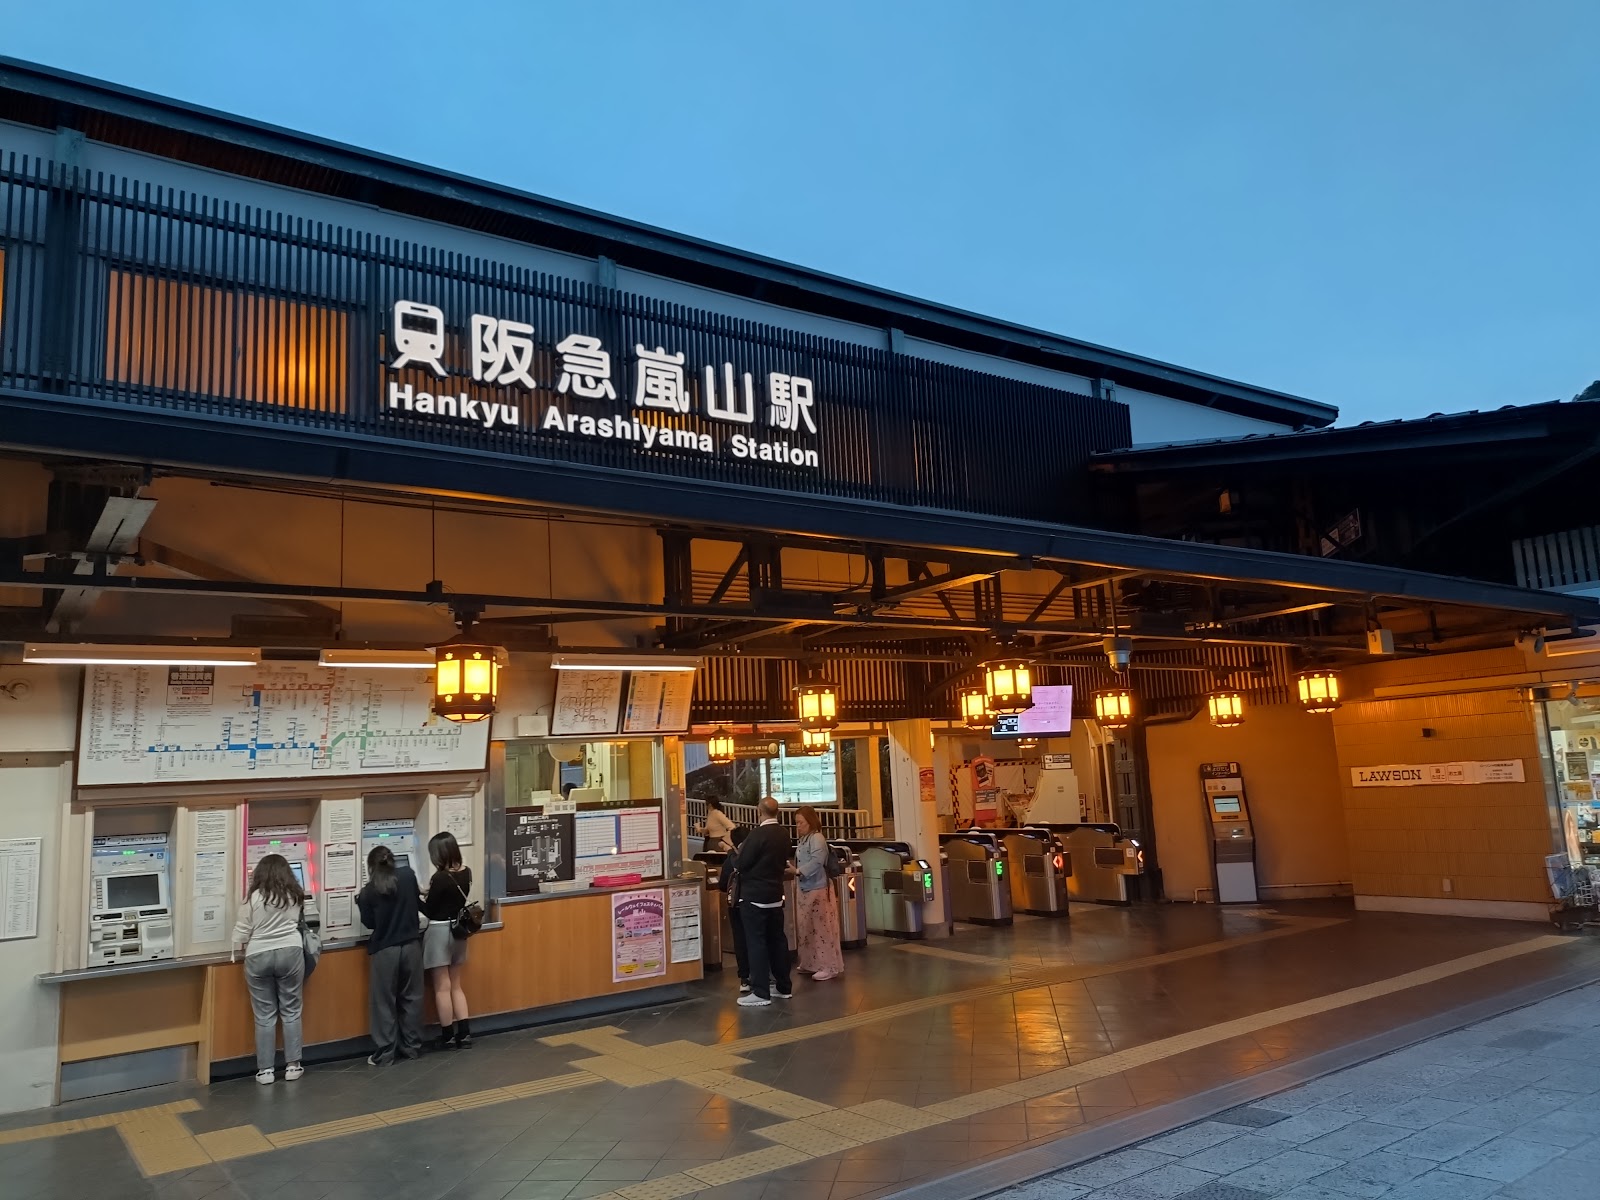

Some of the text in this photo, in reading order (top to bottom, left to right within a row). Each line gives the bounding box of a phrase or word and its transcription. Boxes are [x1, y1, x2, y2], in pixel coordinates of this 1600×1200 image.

[470, 313, 818, 434] 阪急嵐山駅
[388, 382, 819, 469] Hankyu Arashiyama Station
[1358, 769, 1422, 782] LAWSON
